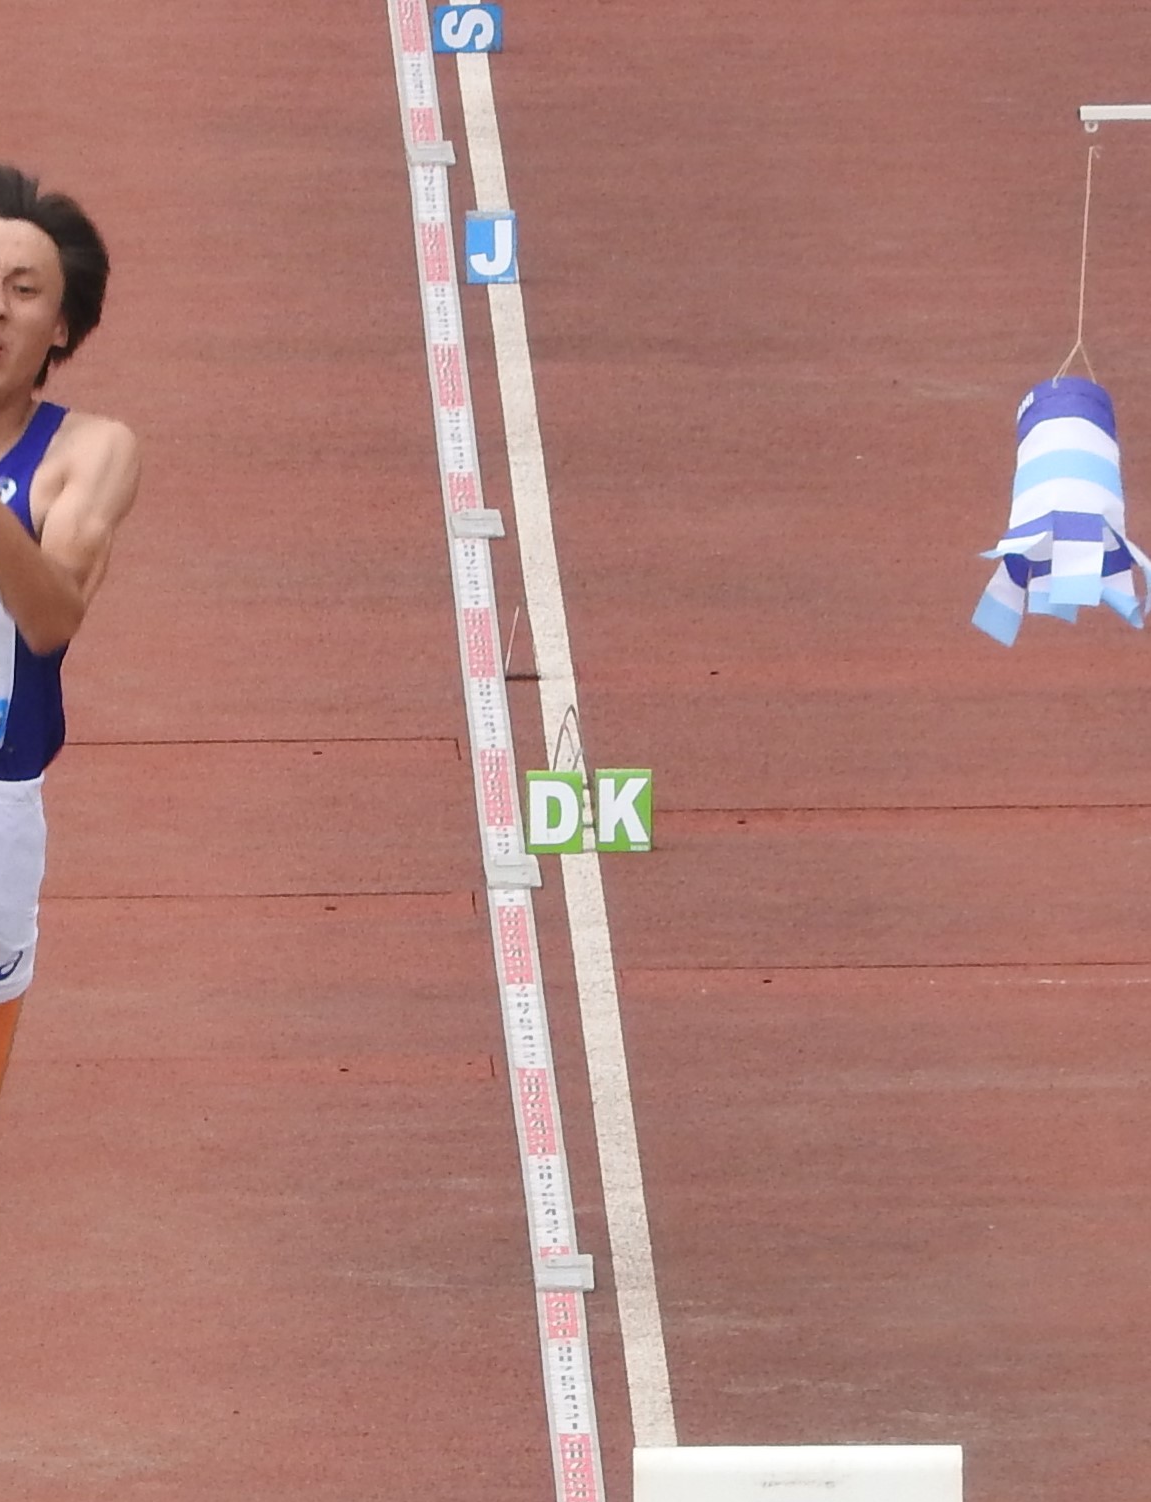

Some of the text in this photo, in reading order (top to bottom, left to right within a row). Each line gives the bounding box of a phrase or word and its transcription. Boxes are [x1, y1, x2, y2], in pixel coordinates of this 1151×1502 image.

[441, 9, 494, 50] S
[470, 219, 512, 276] J
[530, 780, 579, 844] D
[599, 778, 649, 842] K
